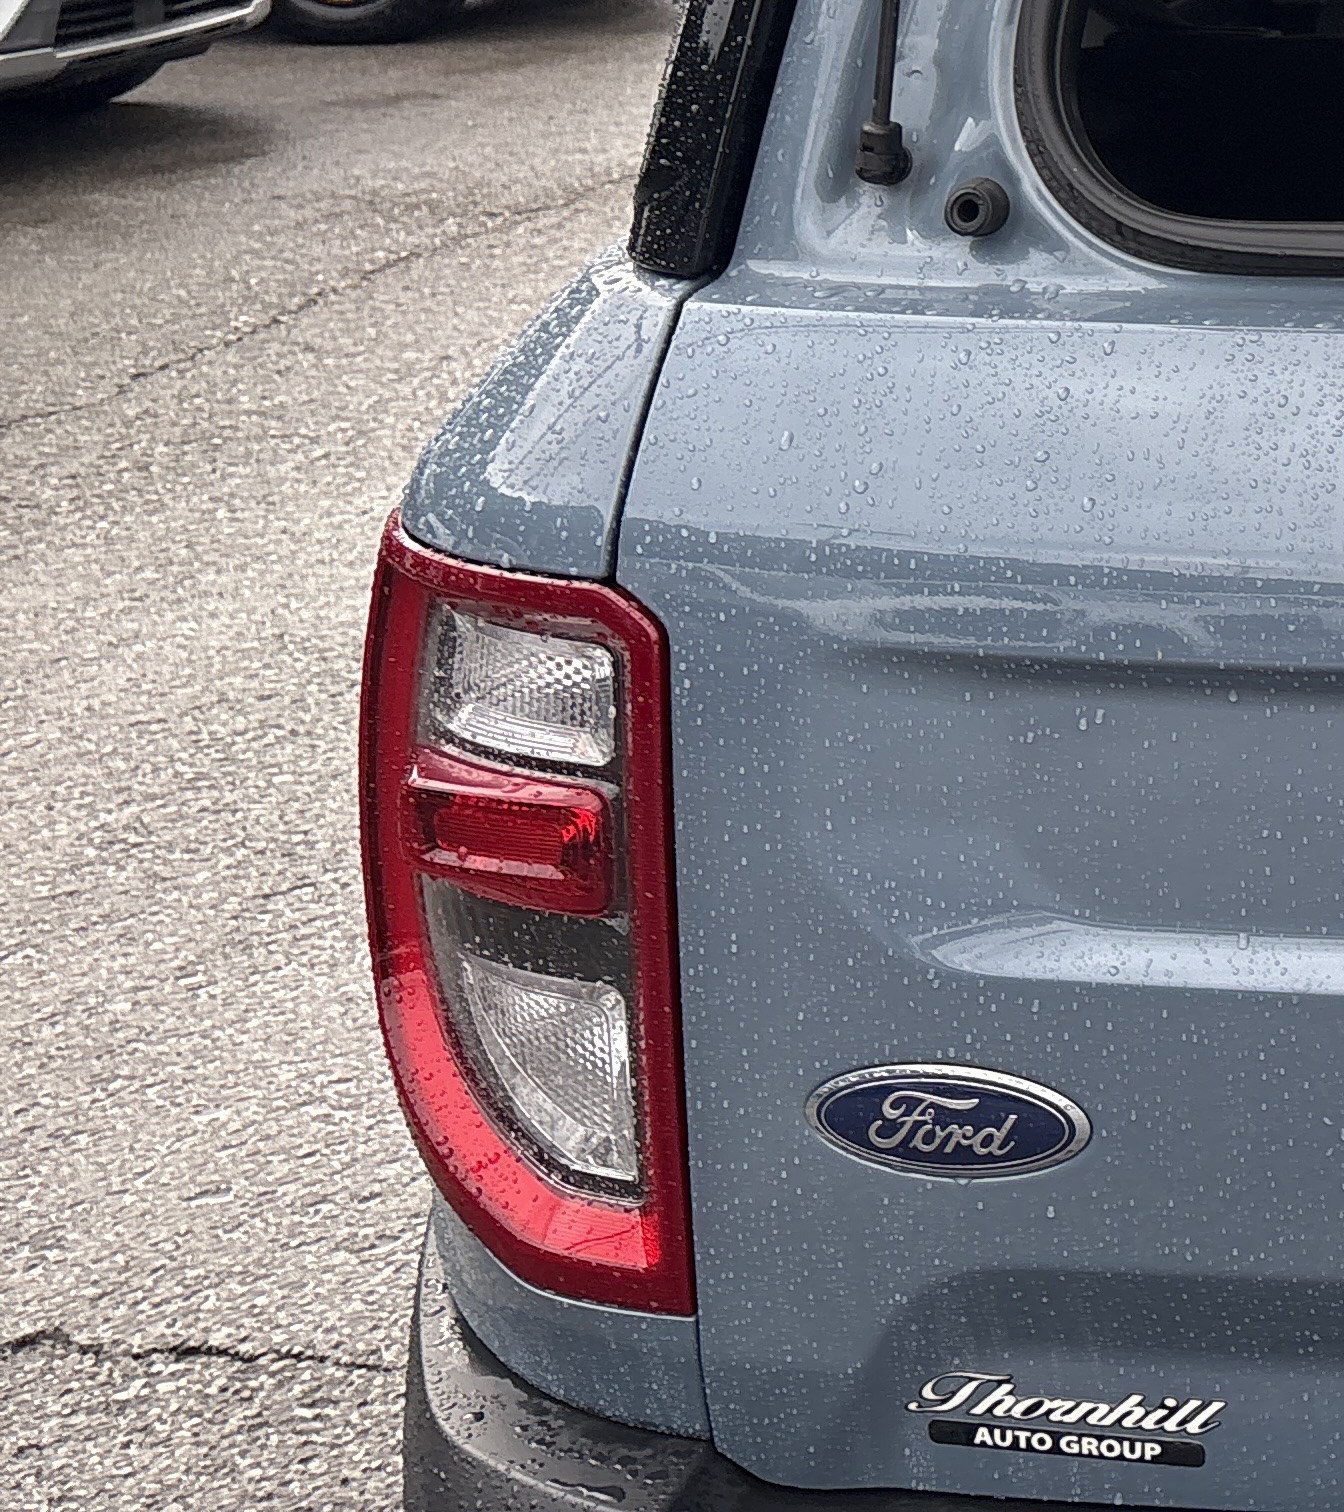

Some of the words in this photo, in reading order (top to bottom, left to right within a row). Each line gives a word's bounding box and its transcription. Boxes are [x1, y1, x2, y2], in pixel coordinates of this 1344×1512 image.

[867, 1090, 1018, 1157] Ford
[907, 1371, 1227, 1434] Thornhill
[973, 1426, 1053, 1451] AUTO
[1059, 1435, 1162, 1461] GROUP
